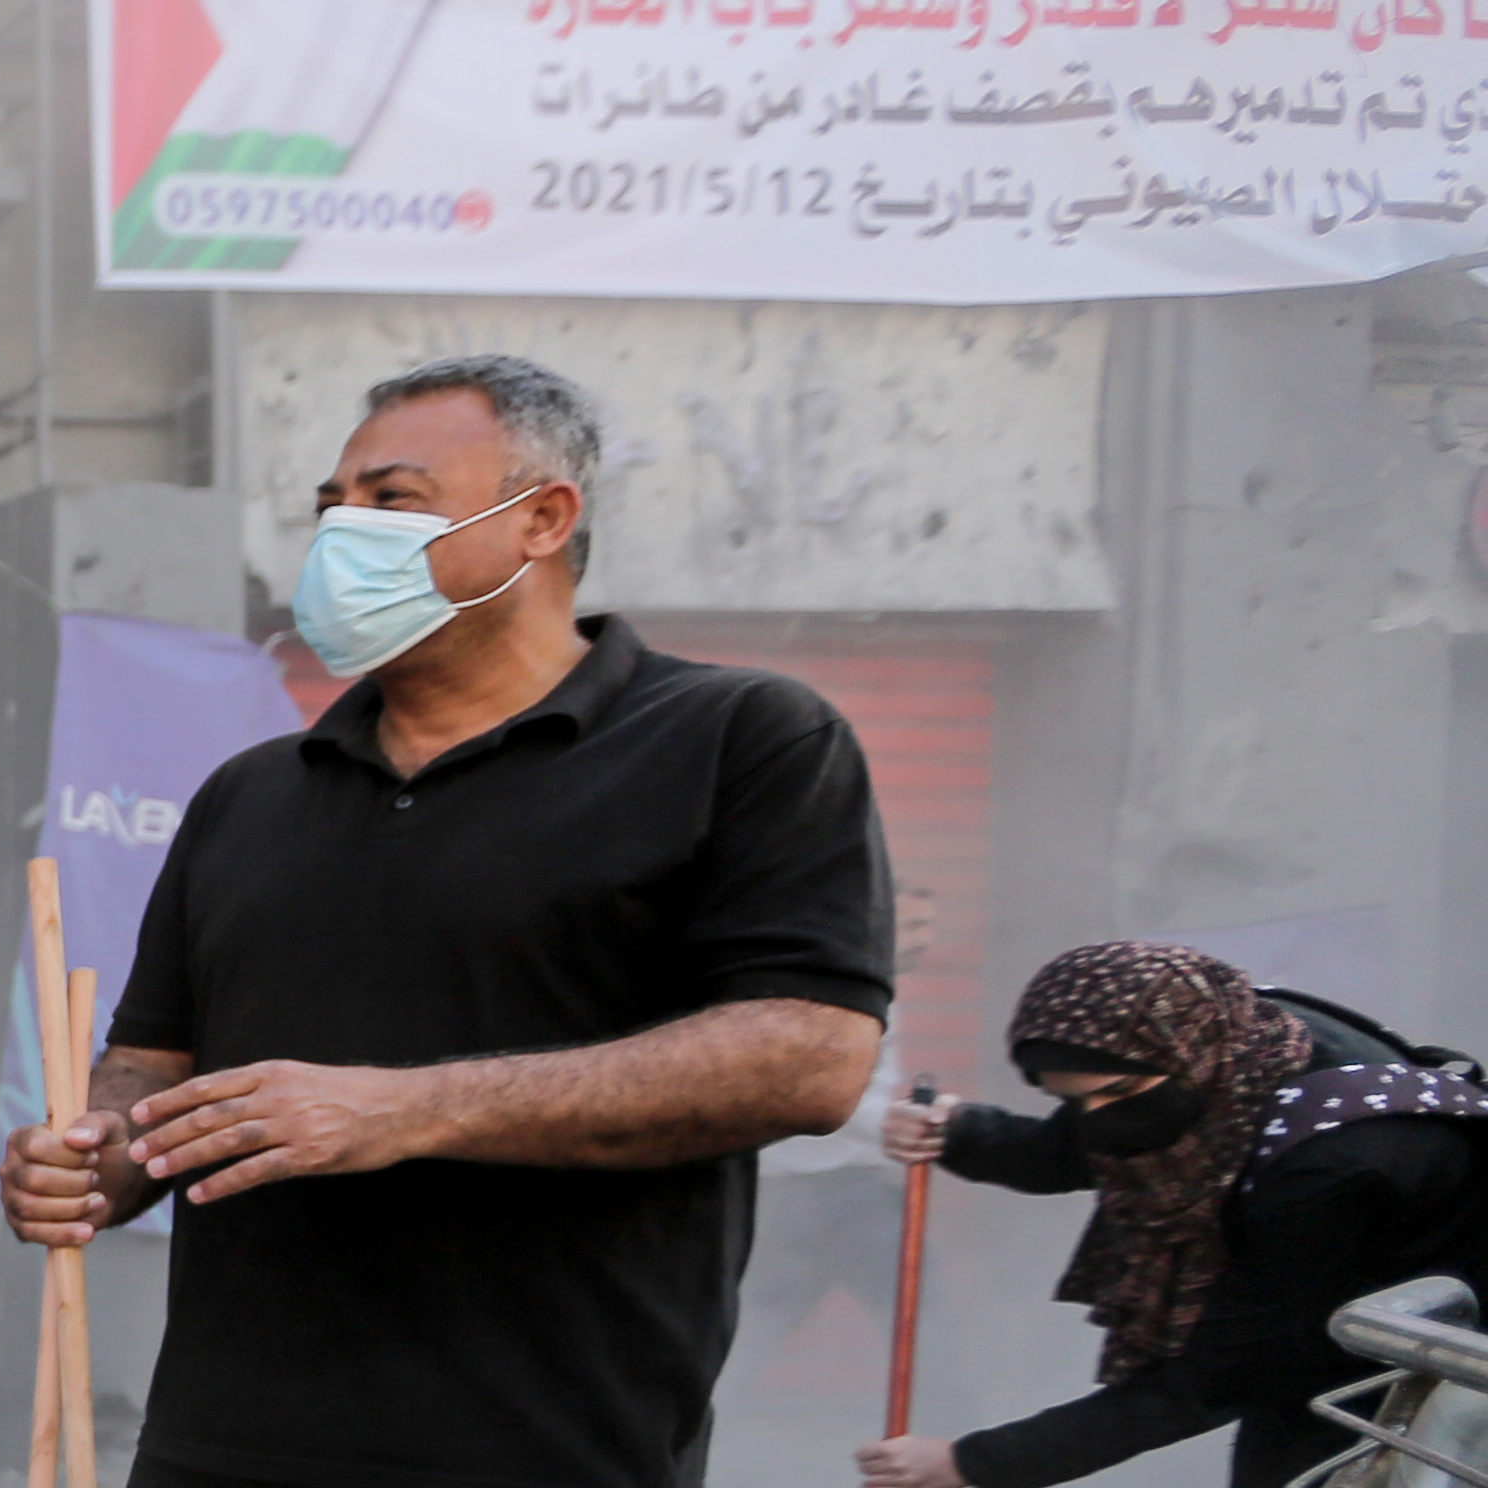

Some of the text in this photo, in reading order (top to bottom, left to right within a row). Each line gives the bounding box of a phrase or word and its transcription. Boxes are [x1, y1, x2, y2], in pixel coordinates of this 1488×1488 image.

[738, 69, 803, 138] من
[814, 67, 932, 135] غادر
[946, 60, 1116, 138] بقصف
[1357, 74, 1426, 144] تم
[165, 184, 458, 232] 0597500040
[530, 160, 835, 215] 2021/5/12
[851, 162, 1034, 240] بتاريخ
